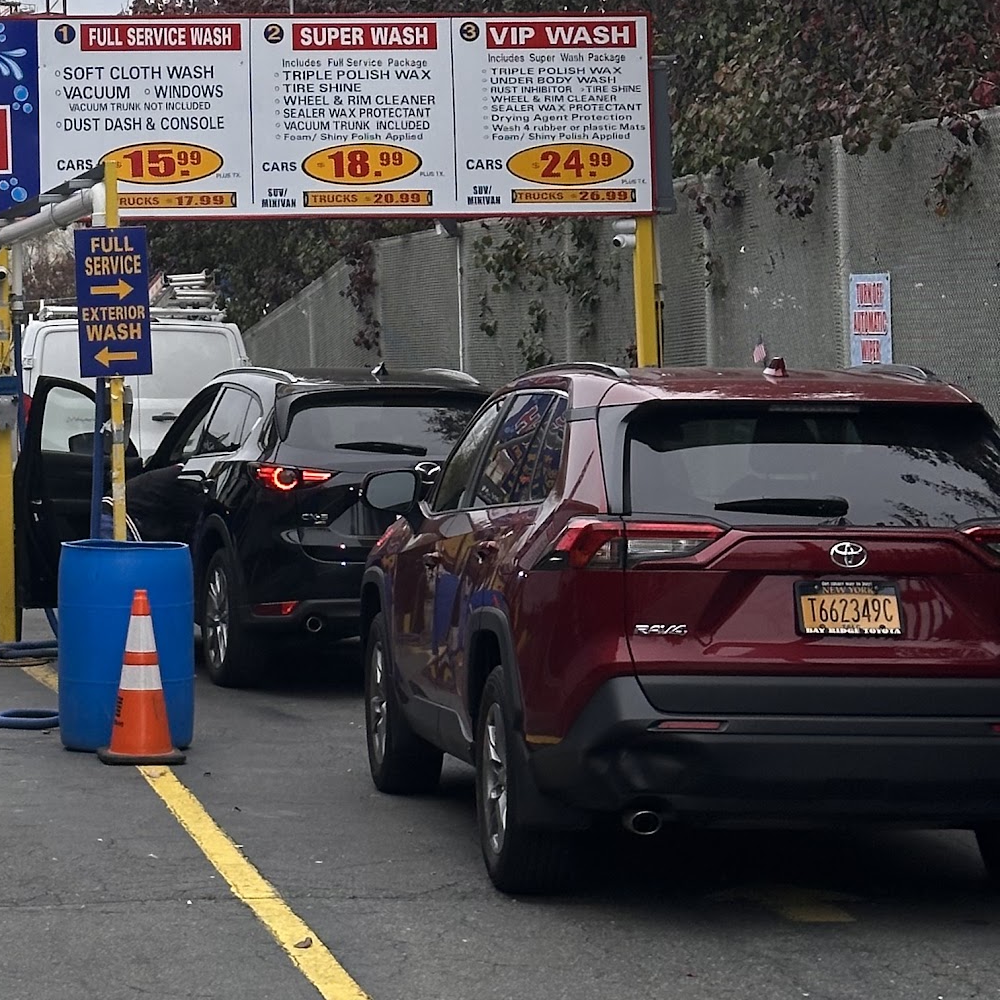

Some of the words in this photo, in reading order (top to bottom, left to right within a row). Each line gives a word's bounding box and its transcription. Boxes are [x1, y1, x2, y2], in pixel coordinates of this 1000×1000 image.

[58, 26, 68, 41] 1
[267, 26, 280, 41] 2
[300, 27, 364, 45] SUPER
[370, 27, 428, 45] WASH
[463, 24, 476, 39] 3
[489, 27, 535, 45] VIP
[545, 26, 629, 44] WASH
[89, 28, 123, 46] FULL
[127, 28, 186, 46] SERVICE
[190, 28, 231, 45] WASH
[282, 59, 321, 67] Includes
[328, 58, 344, 67] Full
[347, 58, 382, 67] Service
[388, 58, 427, 68] Package
[488, 53, 524, 63] Includes
[530, 54, 555, 63] Super
[561, 53, 583, 62] Wash
[588, 53, 626, 63] Package
[63, 67, 104, 80] SOFT
[110, 66, 161, 79] CLOTH
[166, 66, 214, 79] WASH
[283, 71, 332, 80] TRIPLE
[337, 70, 389, 80] POLISH
[395, 70, 431, 79] WAX
[63, 86, 130, 99] VACUUM
[154, 85, 223, 98] WINDOWS
[283, 84, 314, 92] TIRE
[320, 83, 361, 92] SHINE
[284, 96, 329, 105] WHEEL
[334, 96, 342, 105] &
[348, 96, 371, 105] RIM
[375, 95, 435, 105] CLEANER
[69, 103, 107, 111] VACUUM
[111, 103, 140, 111] TRUNK
[144, 102, 163, 110] NOT
[166, 102, 211, 110] INCLUDED
[284, 108, 325, 118] SEALER
[330, 108, 355, 118] WAX
[359, 108, 431, 118] PROTECTANT
[64, 118, 100, 131] DUST
[105, 118, 141, 130] DASH
[146, 118, 155, 130] &
[161, 116, 224, 130] CONSOLE
[491, 115, 529, 123] Drying
[533, 114, 568, 122] Agent
[284, 121, 330, 130] VACUUM
[333, 121, 370, 130] TRUNK
[377, 121, 430, 130] INCLUDED
[320, 133, 348, 142] Shiny
[352, 133, 381, 141] Polish
[385, 133, 423, 142] Applied
[528, 133, 556, 142] Shiny
[58, 160, 93, 170] CARS
[262, 162, 297, 171] CARS
[466, 160, 503, 170] CARS
[120, 197, 159, 205] RUCKS
[312, 194, 358, 203] TRUCKS
[91, 236, 134, 253] FULL
[85, 255, 141, 276] SERVICE
[82, 306, 145, 321] EXTERIOR
[86, 323, 142, 341] WASH
[808, 599, 893, 622] T662349C
[634, 625, 688, 635] RAV4
